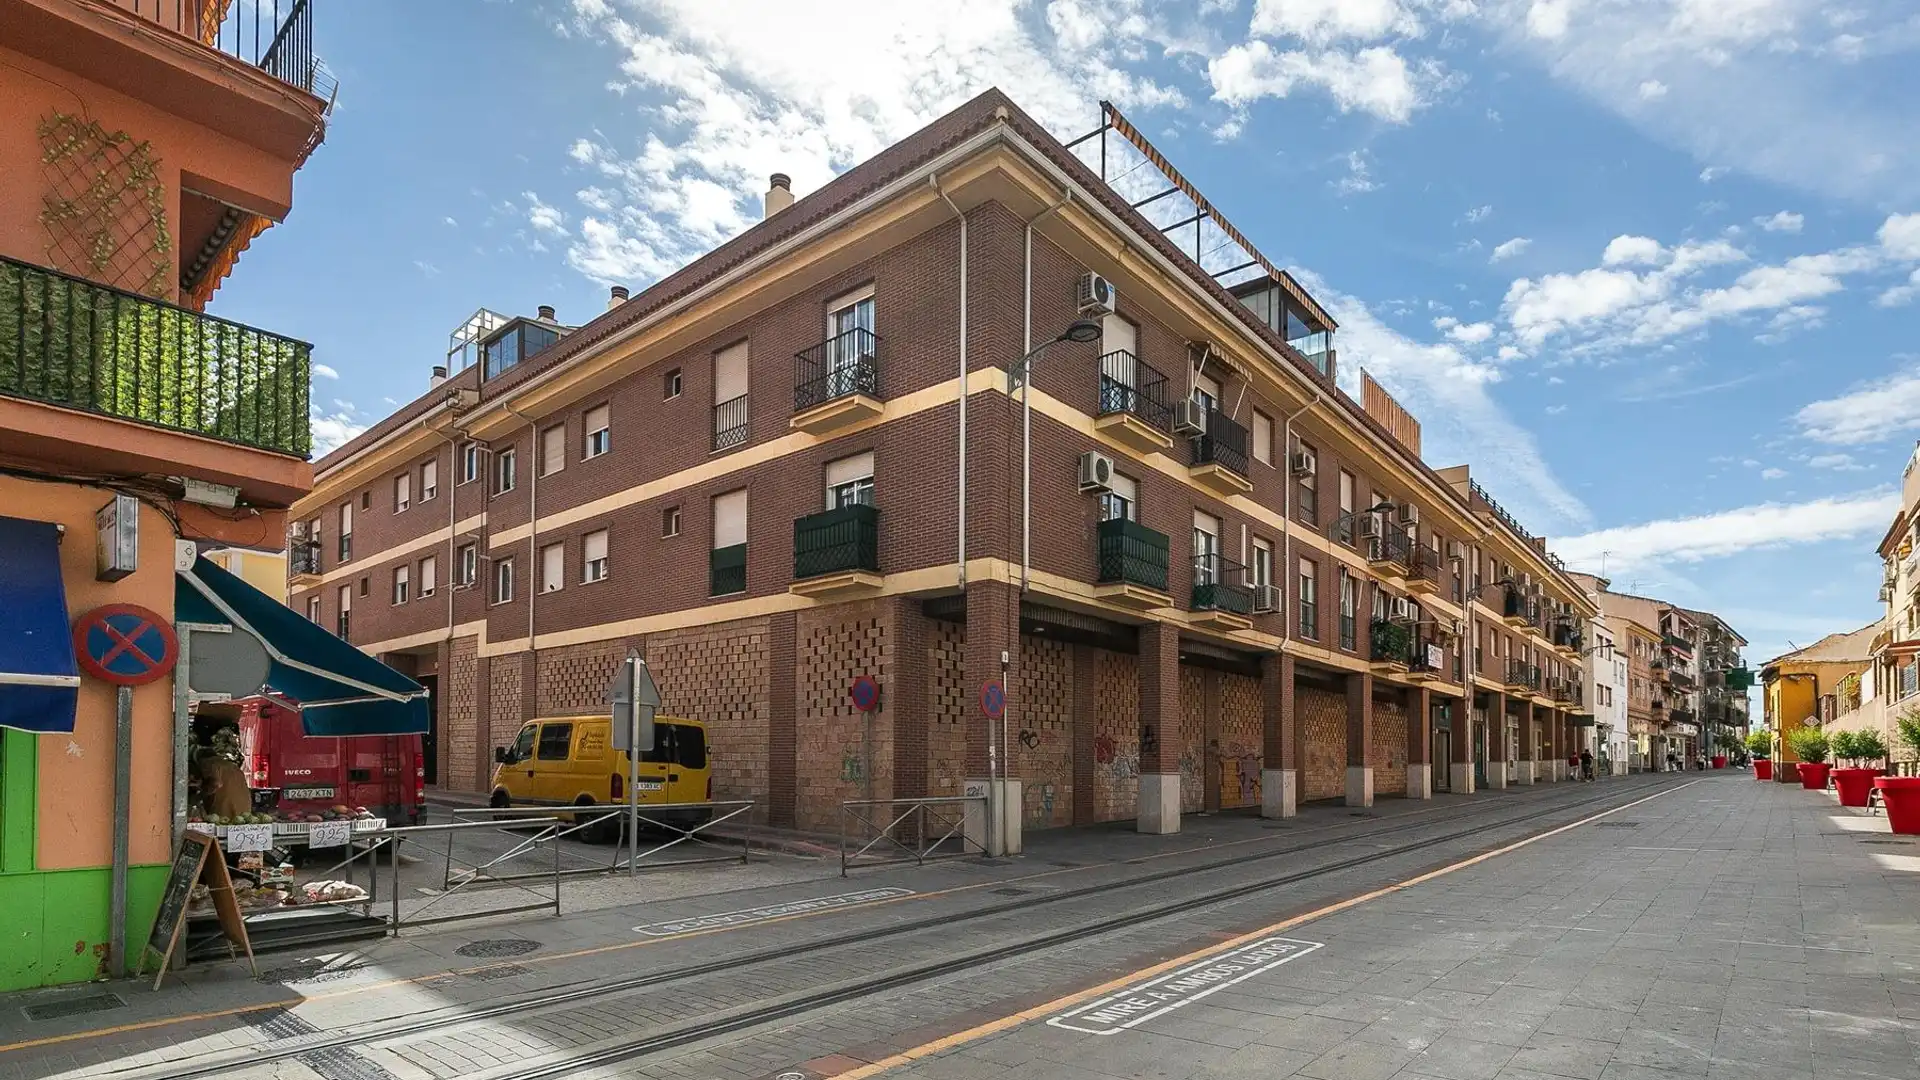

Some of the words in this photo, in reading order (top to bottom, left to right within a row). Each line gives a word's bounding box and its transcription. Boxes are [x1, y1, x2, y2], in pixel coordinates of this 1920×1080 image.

[1081, 997, 1159, 1024] MIRE
[1145, 991, 1180, 1001] A
[1164, 963, 1245, 993] AMBOS
[1231, 943, 1298, 966] LADOS
